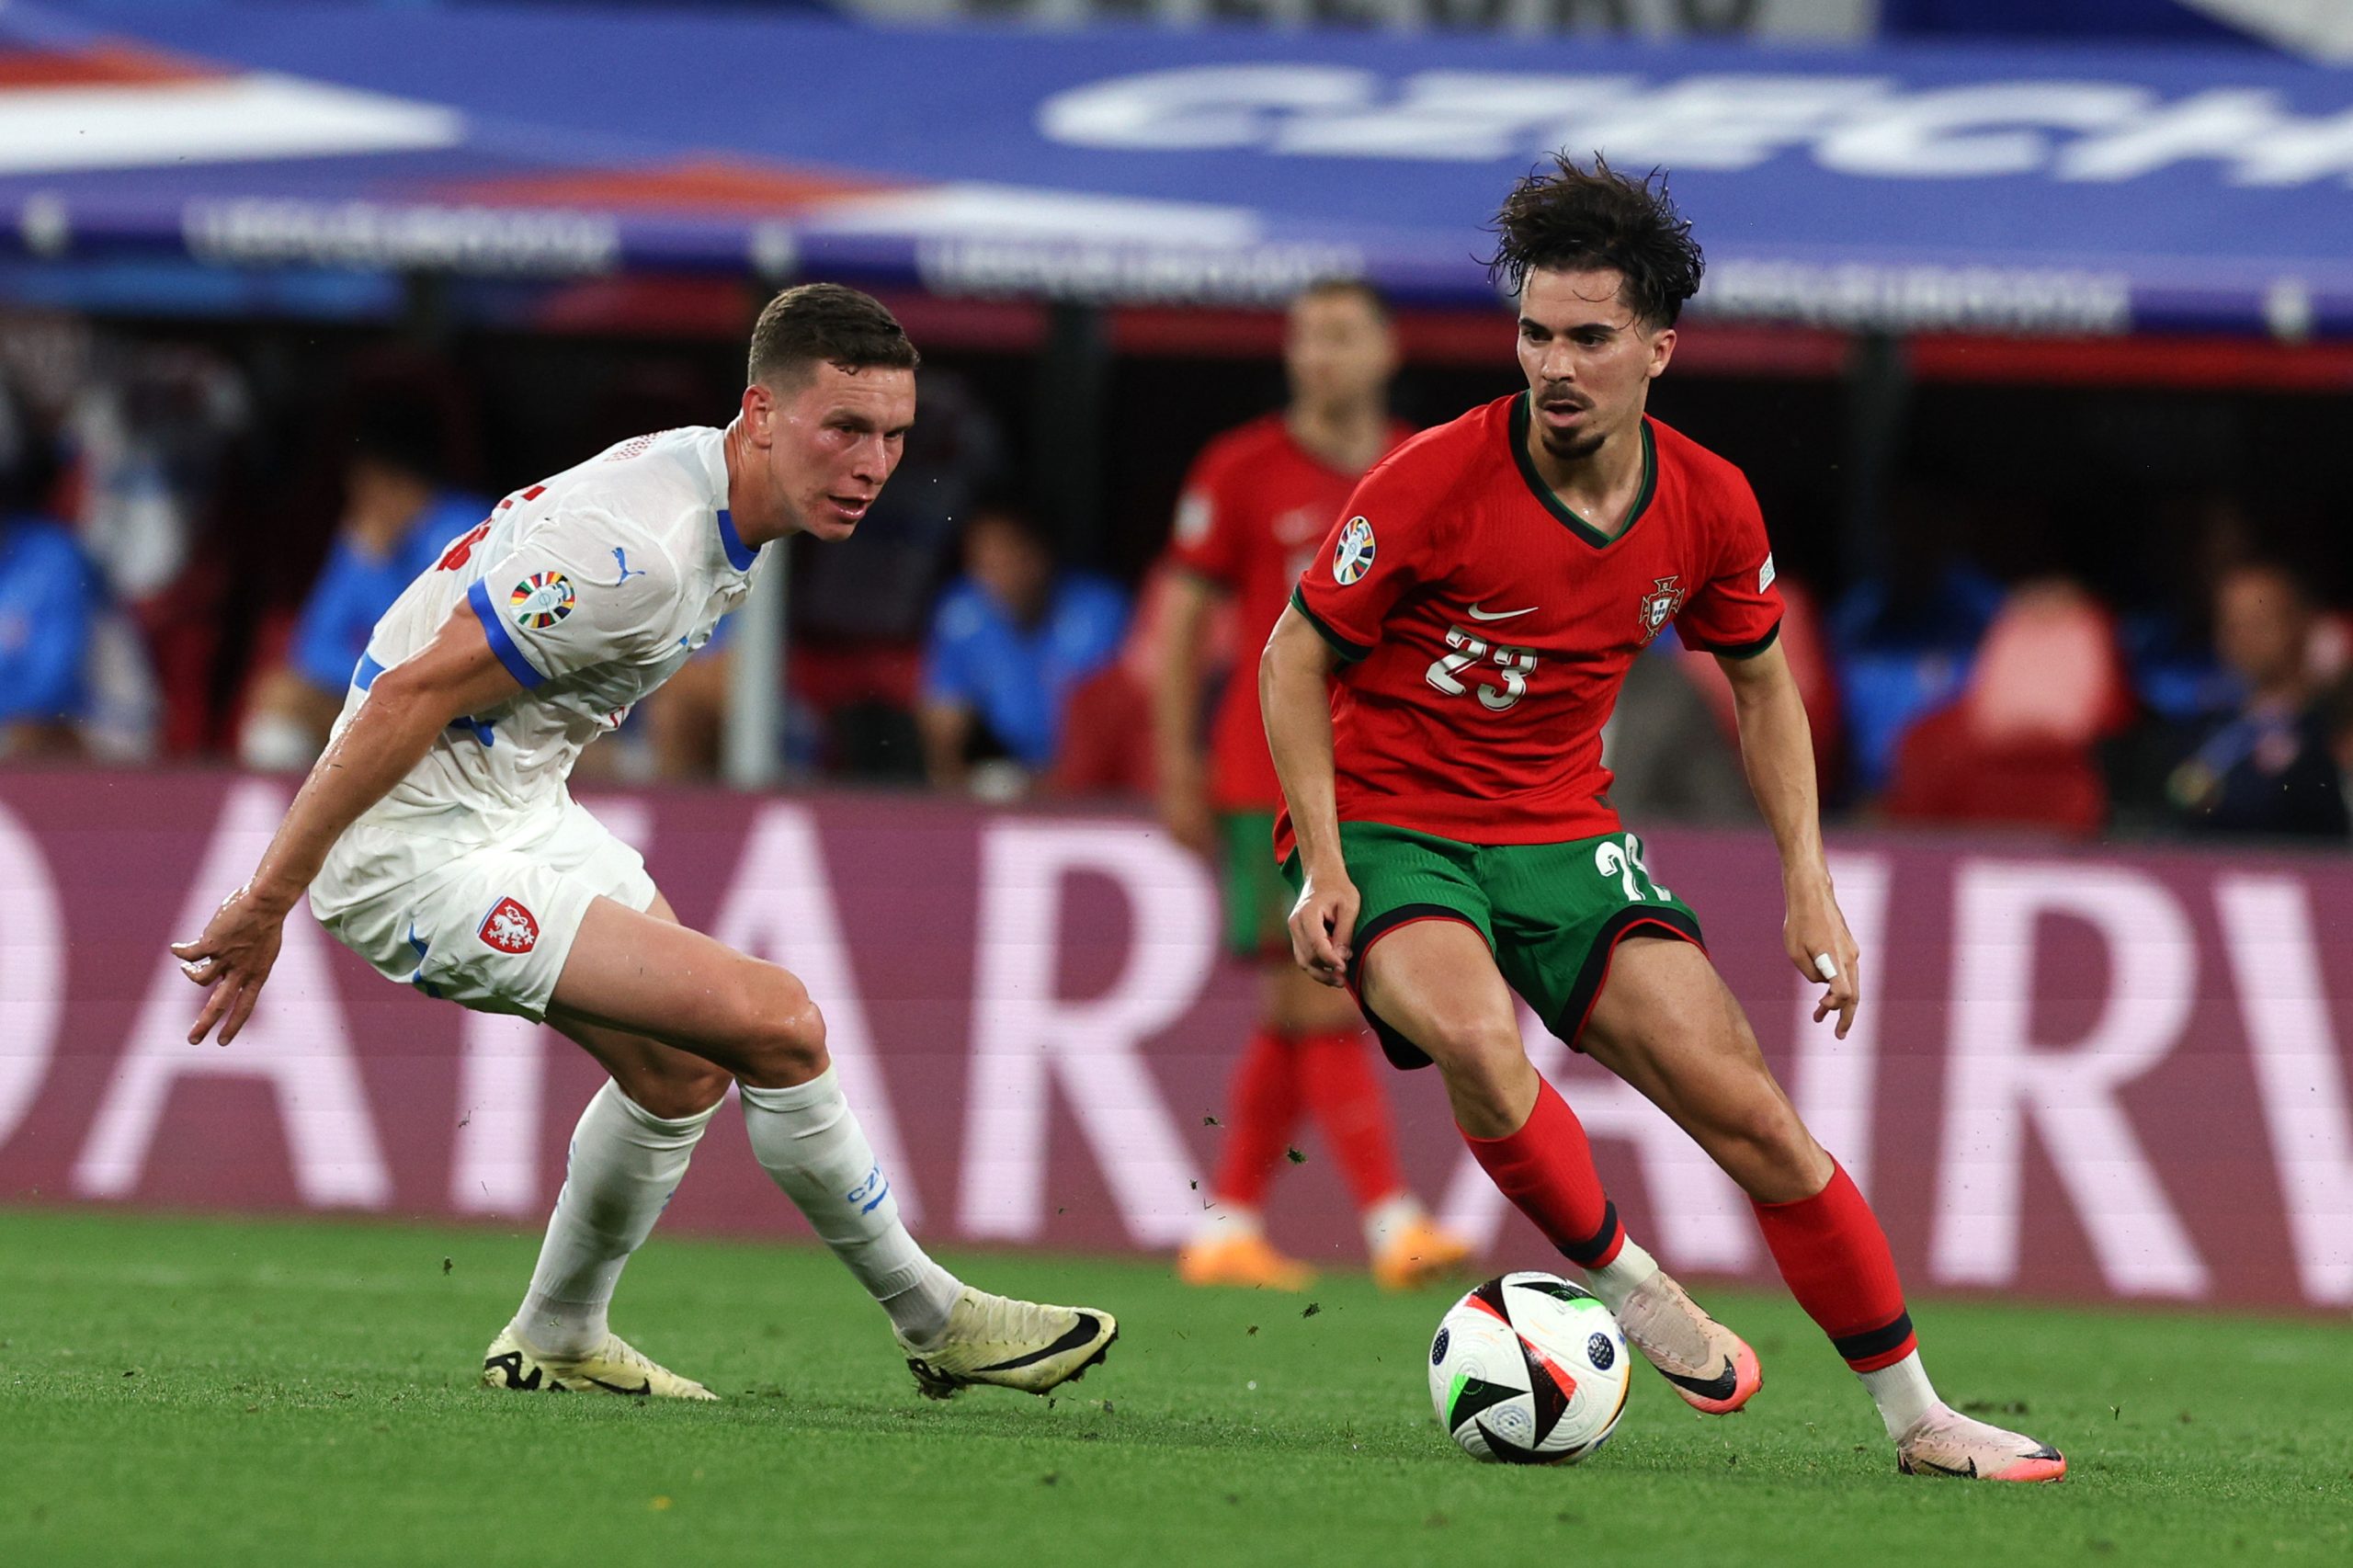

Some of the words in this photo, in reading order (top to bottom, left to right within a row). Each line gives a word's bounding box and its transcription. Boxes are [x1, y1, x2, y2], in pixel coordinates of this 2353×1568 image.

[1426, 624, 1538, 711] 23
[0, 774, 1224, 1247] AAR
[847, 1165, 881, 1203] CZ
